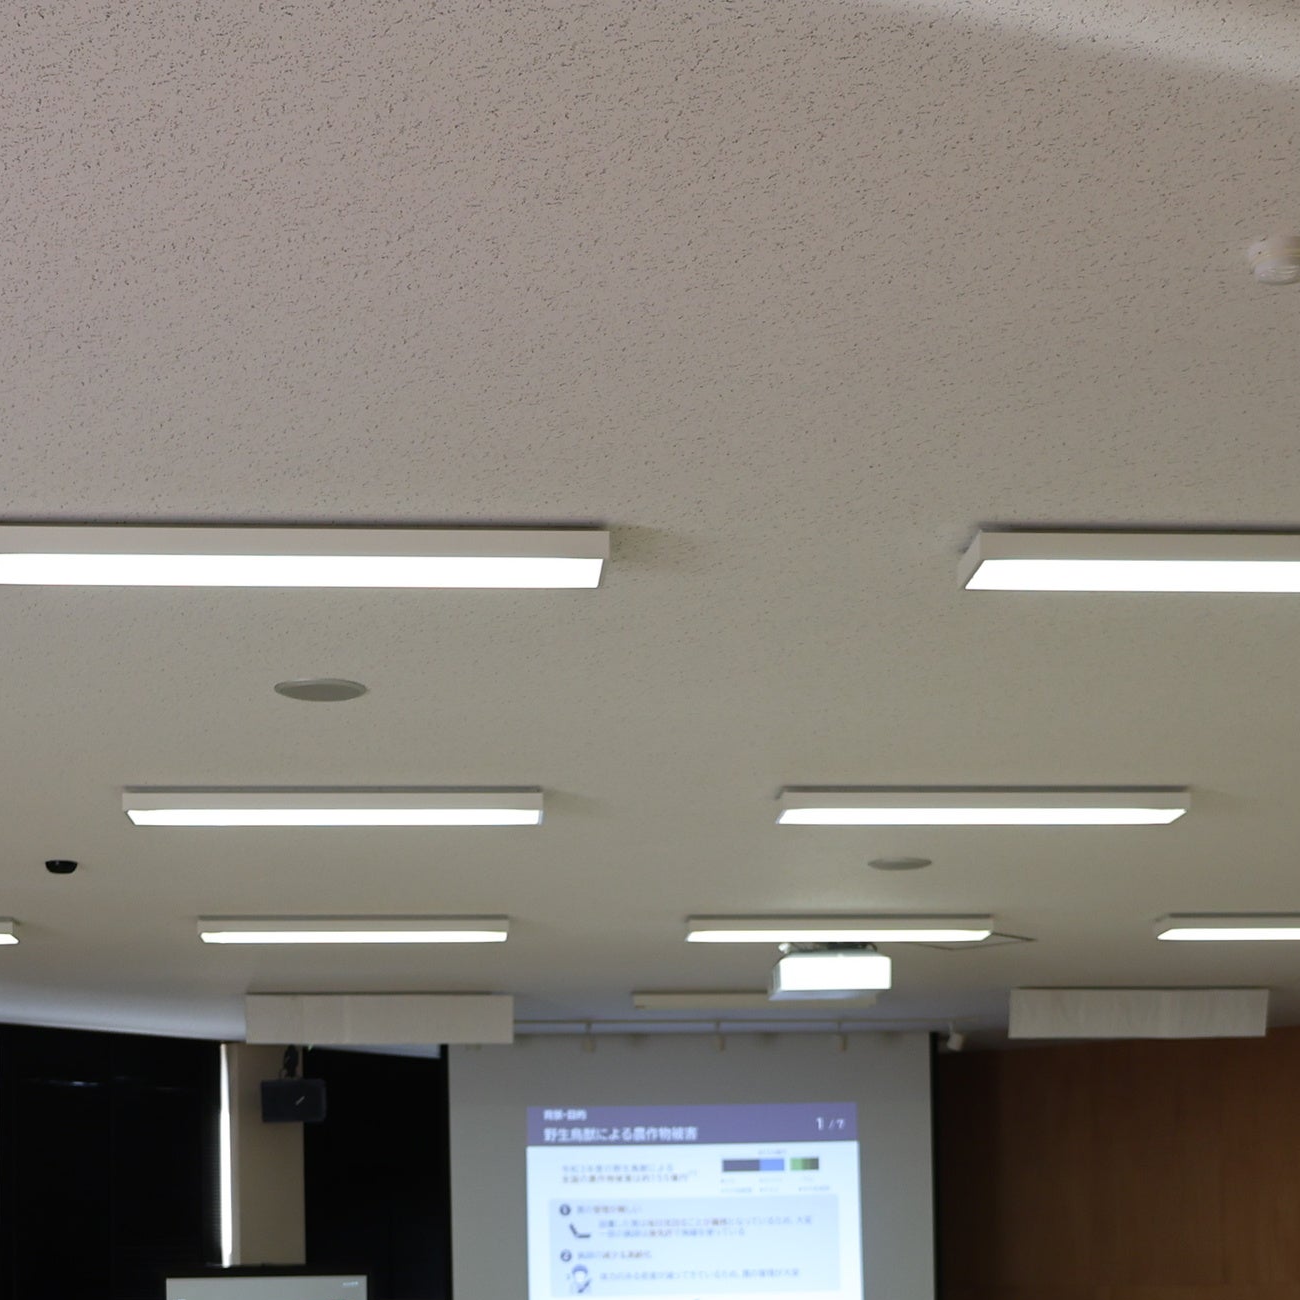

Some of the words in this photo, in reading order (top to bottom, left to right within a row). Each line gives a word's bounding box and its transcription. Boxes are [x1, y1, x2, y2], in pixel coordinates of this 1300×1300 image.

[543, 1127, 698, 1142] 野生鳥獣による農作物被害
